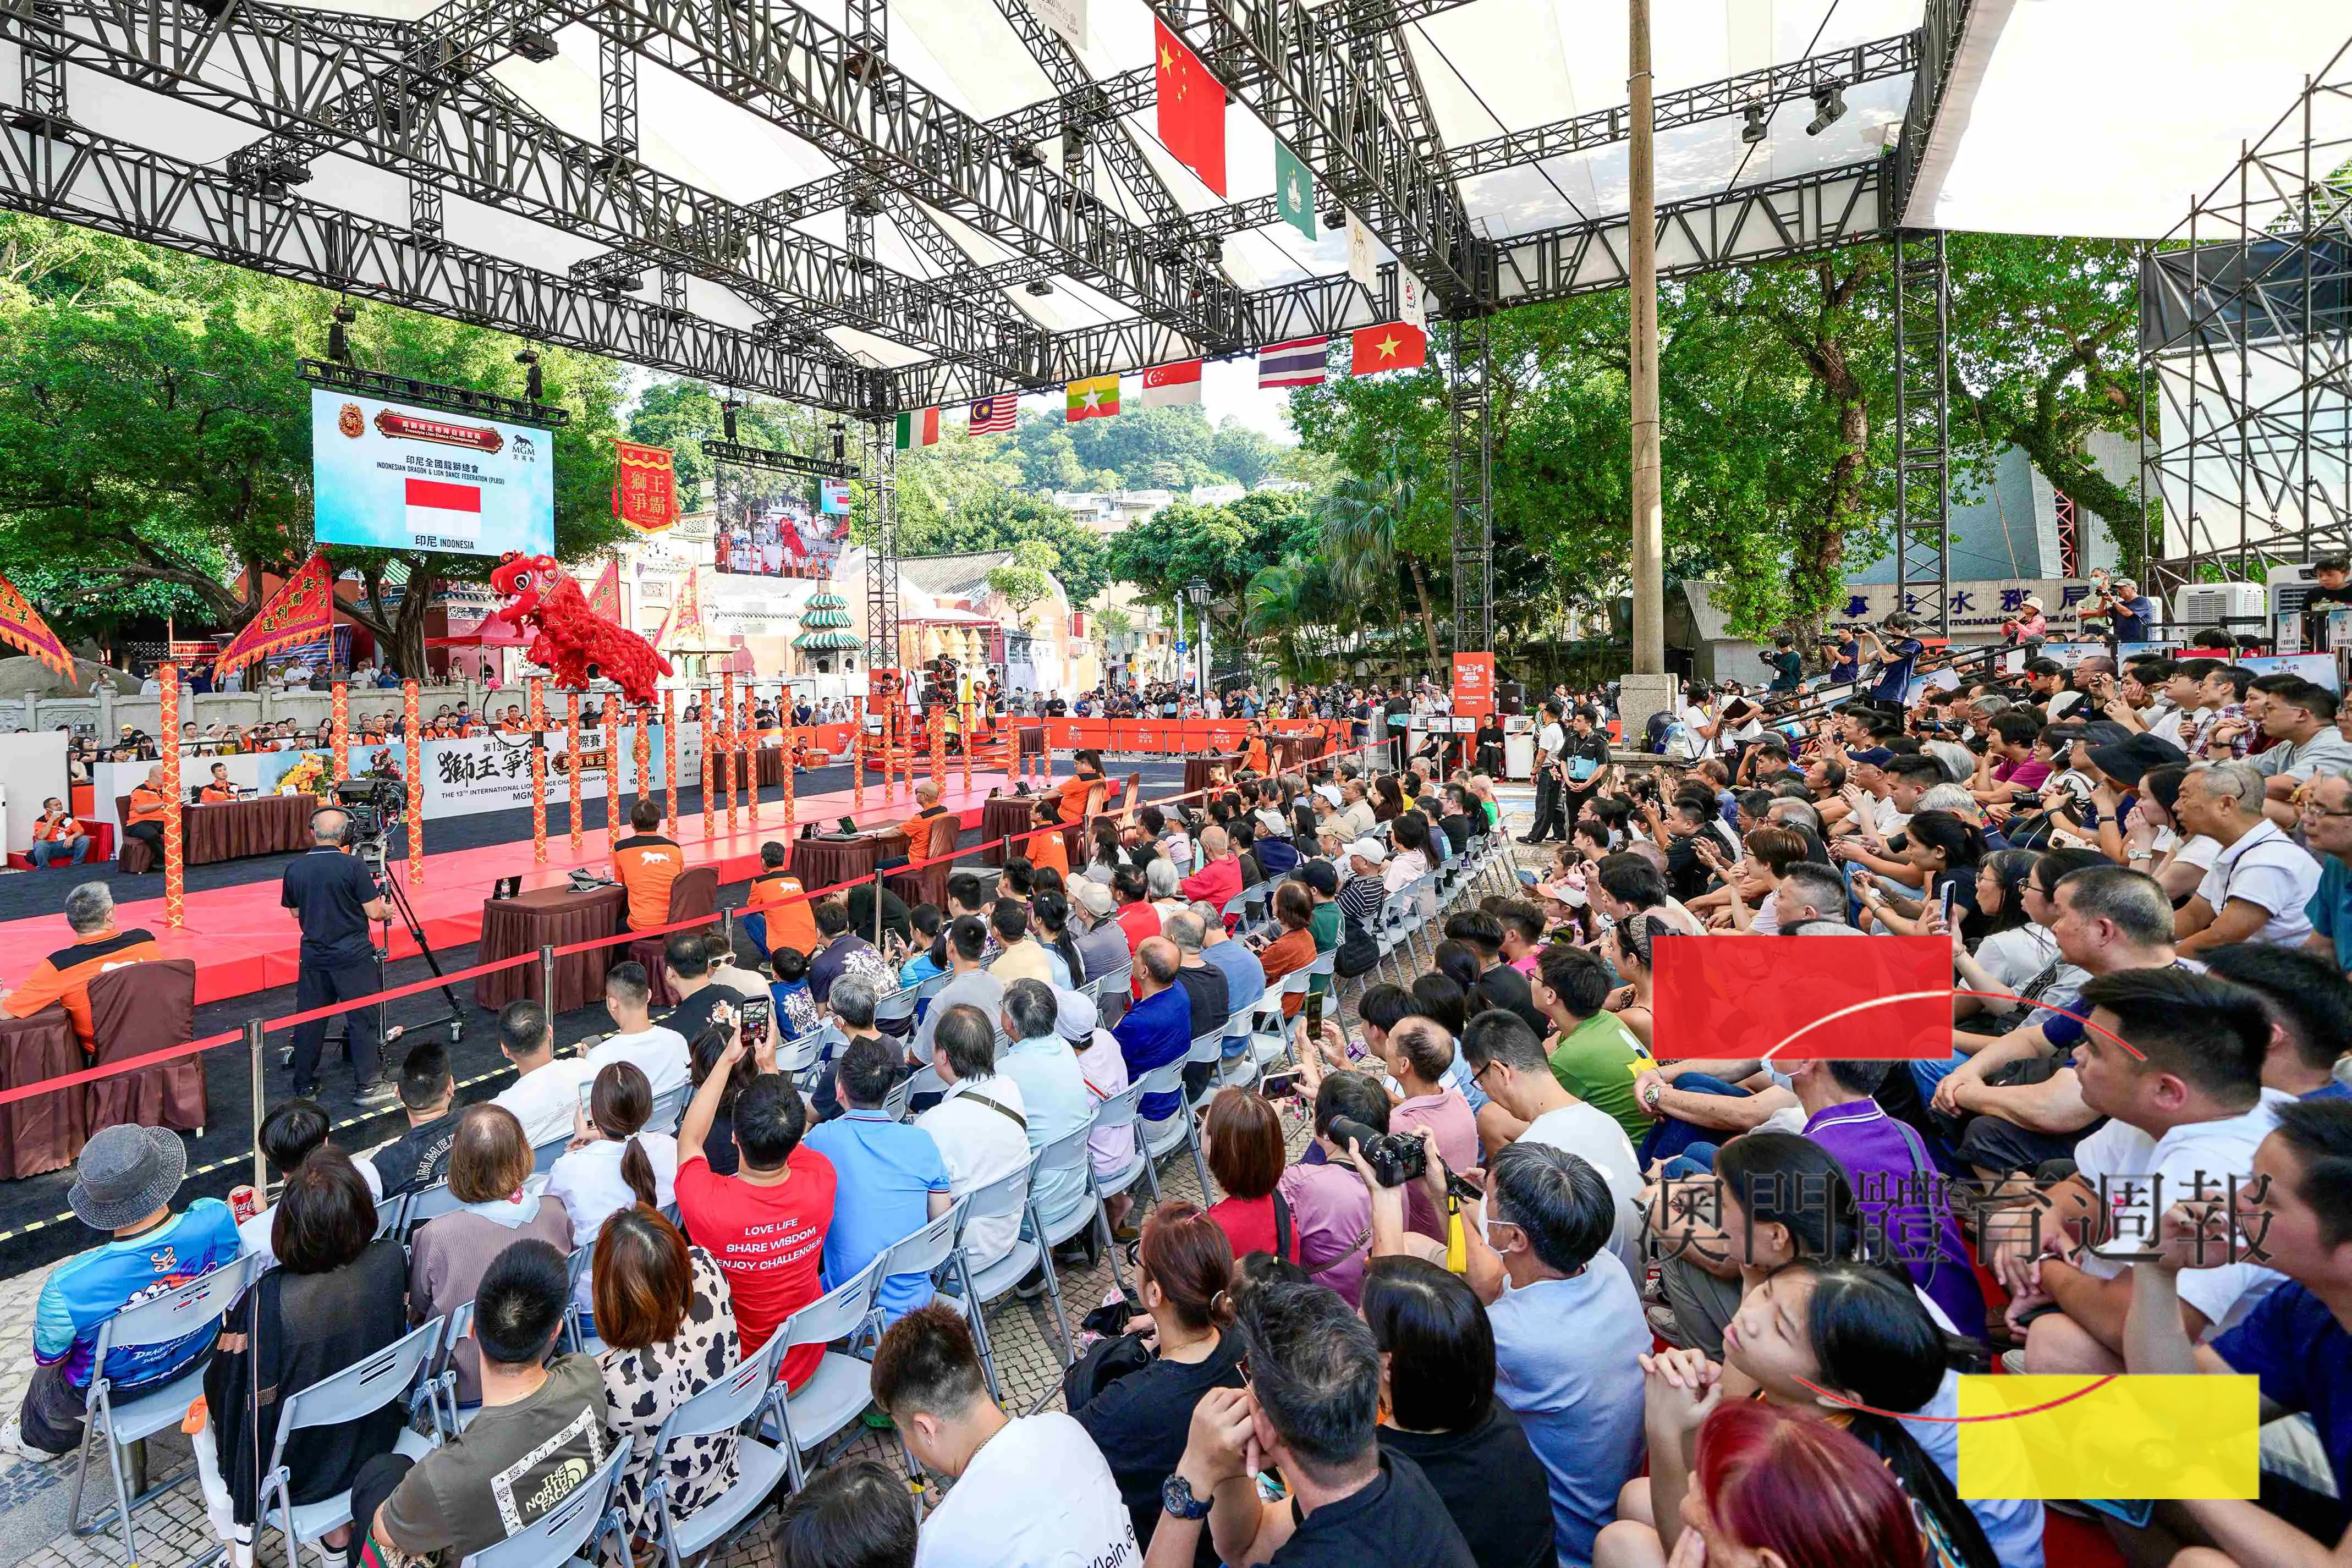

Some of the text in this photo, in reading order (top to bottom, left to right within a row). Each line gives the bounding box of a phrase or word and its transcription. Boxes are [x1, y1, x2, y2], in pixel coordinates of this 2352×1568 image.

[405, 428, 425, 436] Freestyle
[449, 434, 479, 444] Championship
[512, 445, 535, 455] MGM
[377, 461, 406, 471] INDONESIAN
[407, 466, 427, 474] DRAGON
[446, 471, 460, 479] DANCE
[461, 473, 487, 483] FEDERATION
[406, 455, 479, 474] 印尼全國龍獅總會
[631, 471, 665, 493] 獅王
[415, 535, 437, 547] 印尼
[440, 538, 474, 550] INDONESIA
[470, 784, 519, 796] INTERNATIONAL
[558, 775, 599, 785] CHAONSHIP
[513, 792, 534, 801] MGM
[745, 1218, 799, 1236] LOVE LIFE
[726, 1226, 816, 1253] SHARE WISDOM
[717, 1258, 757, 1270] ENJOY
[541, 1464, 564, 1486] THE
[525, 1474, 568, 1512] NORTH
[542, 1485, 570, 1512] FACE
